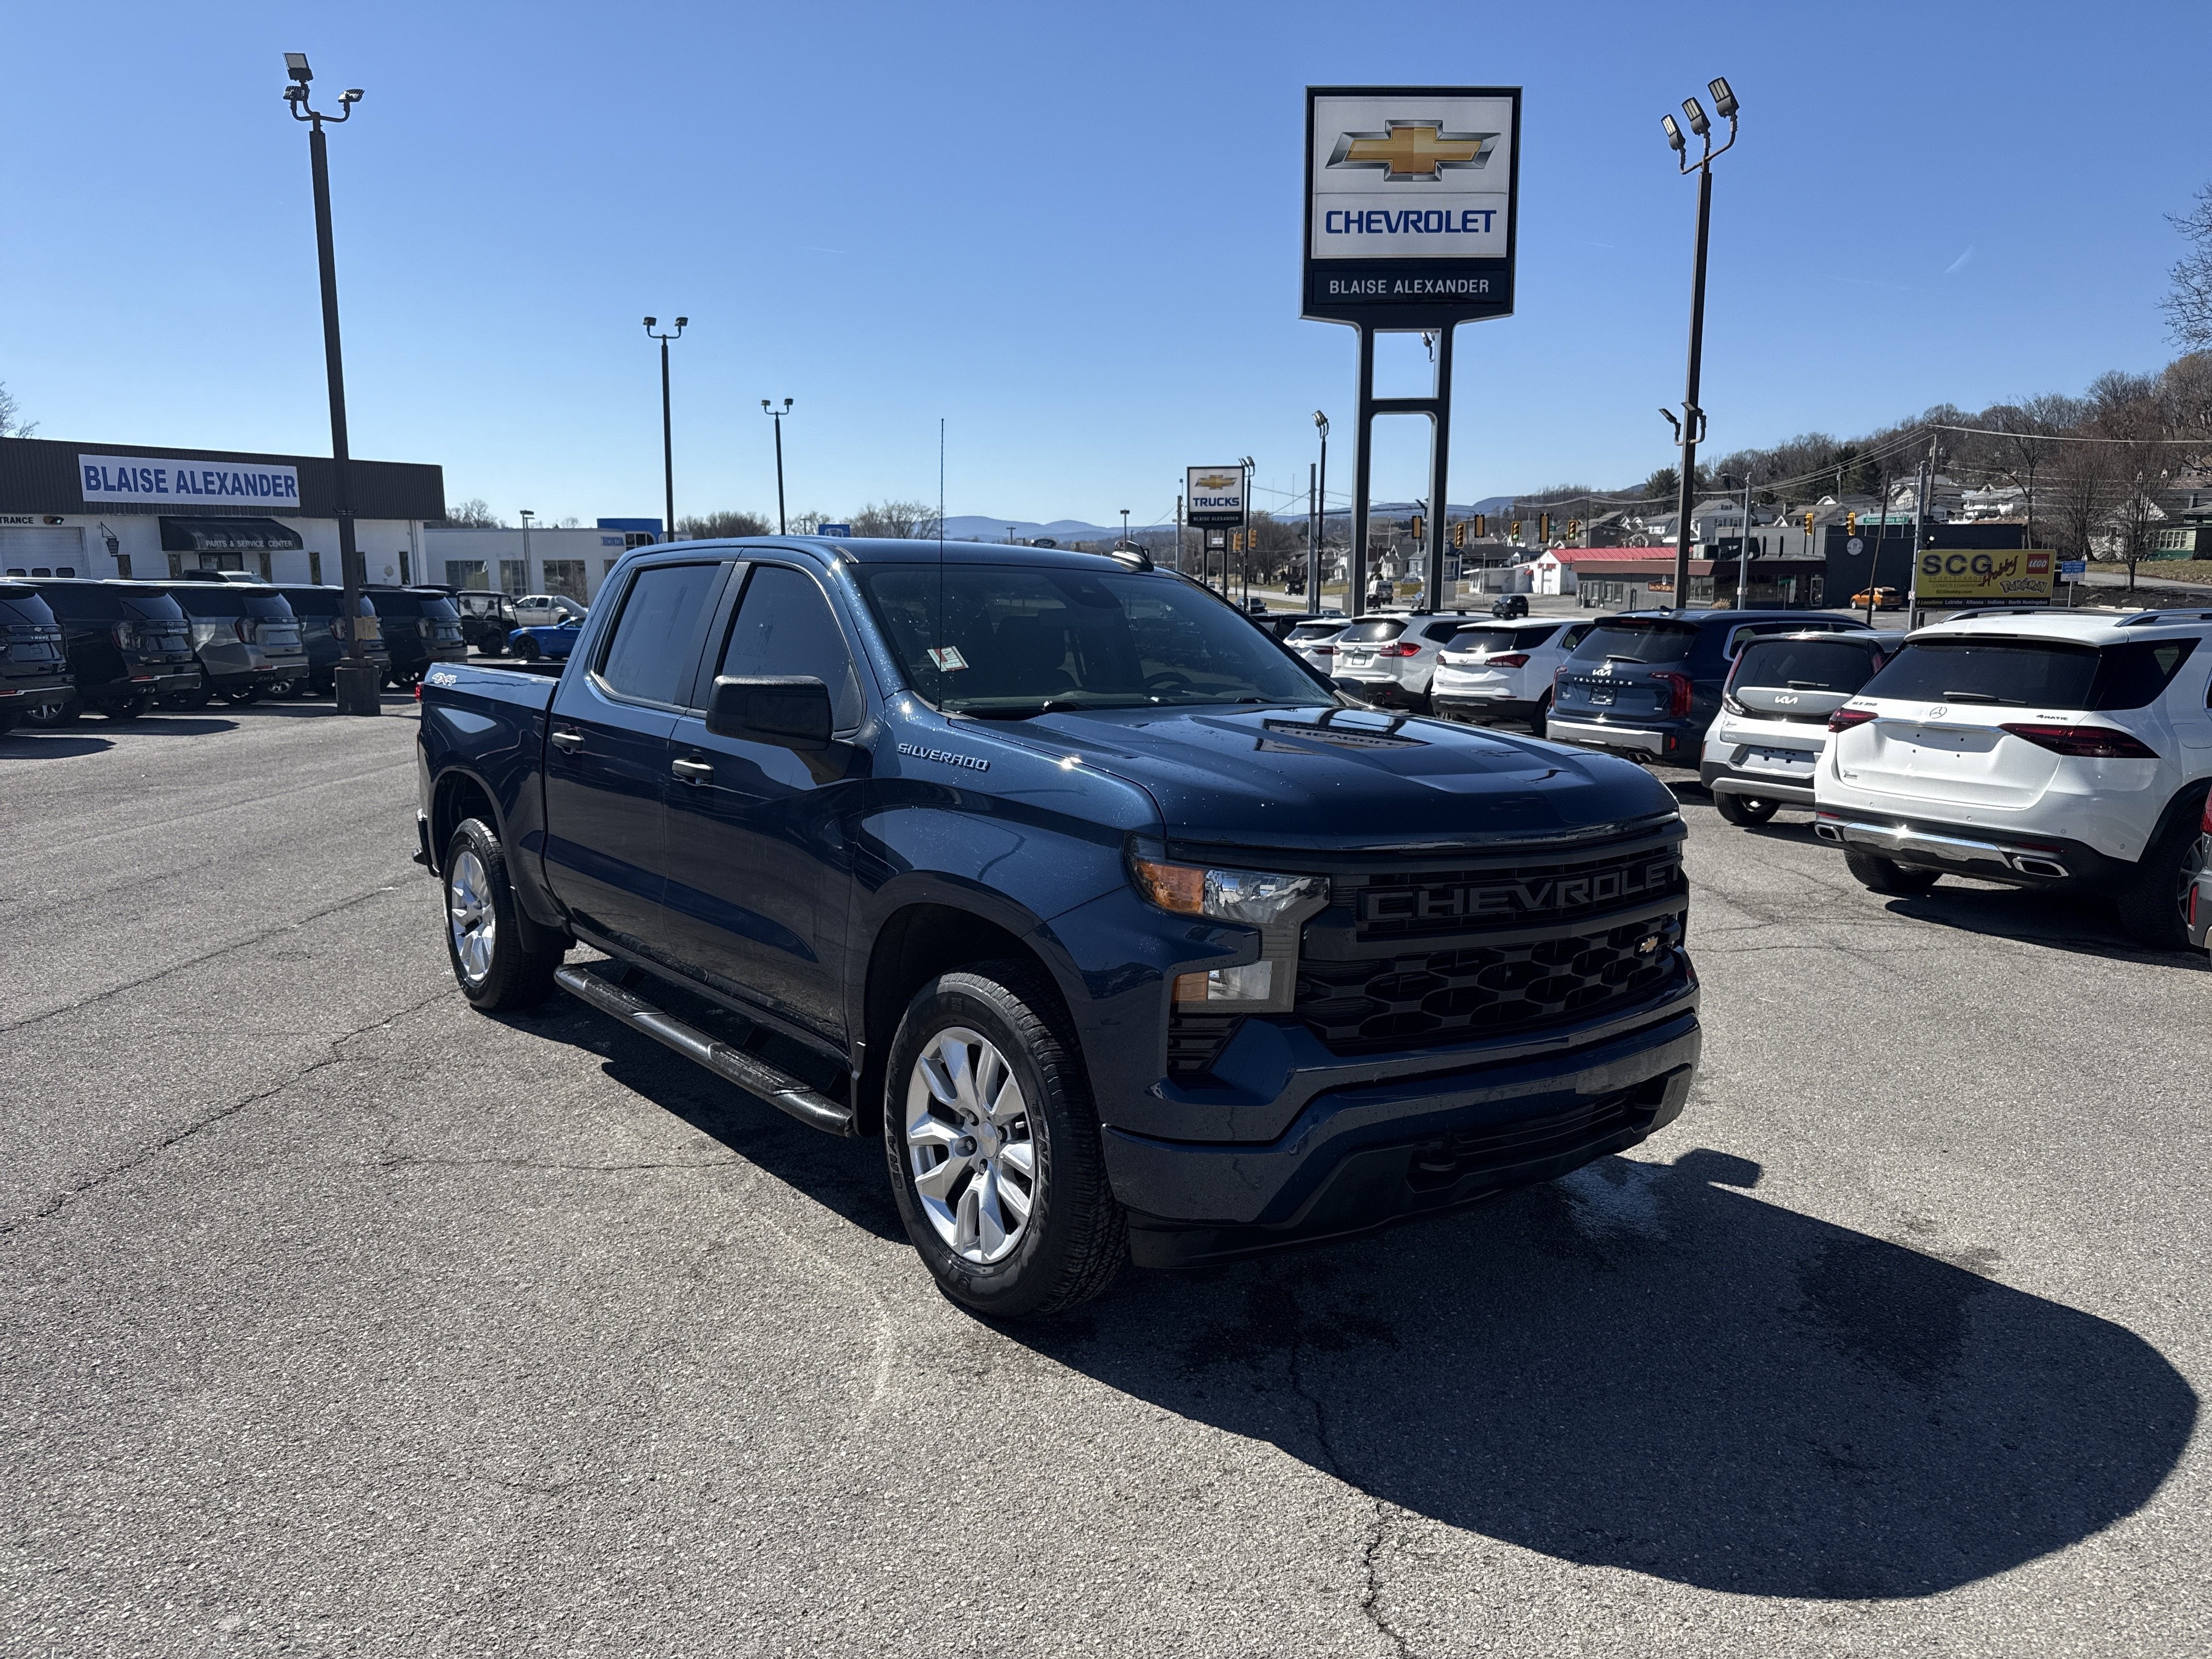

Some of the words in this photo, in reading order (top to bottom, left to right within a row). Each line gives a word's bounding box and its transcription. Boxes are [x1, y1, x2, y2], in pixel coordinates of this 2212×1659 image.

[1325, 210, 1497, 234] CHEVROLET
[1329, 280, 1387, 294] BLAISE
[1393, 279, 1489, 294] ALEXANDER
[84, 465, 168, 493] BLAISE
[176, 470, 297, 497] ALEXANDER
[1193, 497, 1239, 506] TRUCKS
[602, 537, 624, 546] HONDA
[1921, 555, 1993, 576] SCG
[1978, 555, 2018, 587] Hobby
[1573, 677, 1633, 686] TELLURIDE
[897, 742, 990, 772] SILVERADO
[1363, 861, 1680, 922] CHEVROLET
